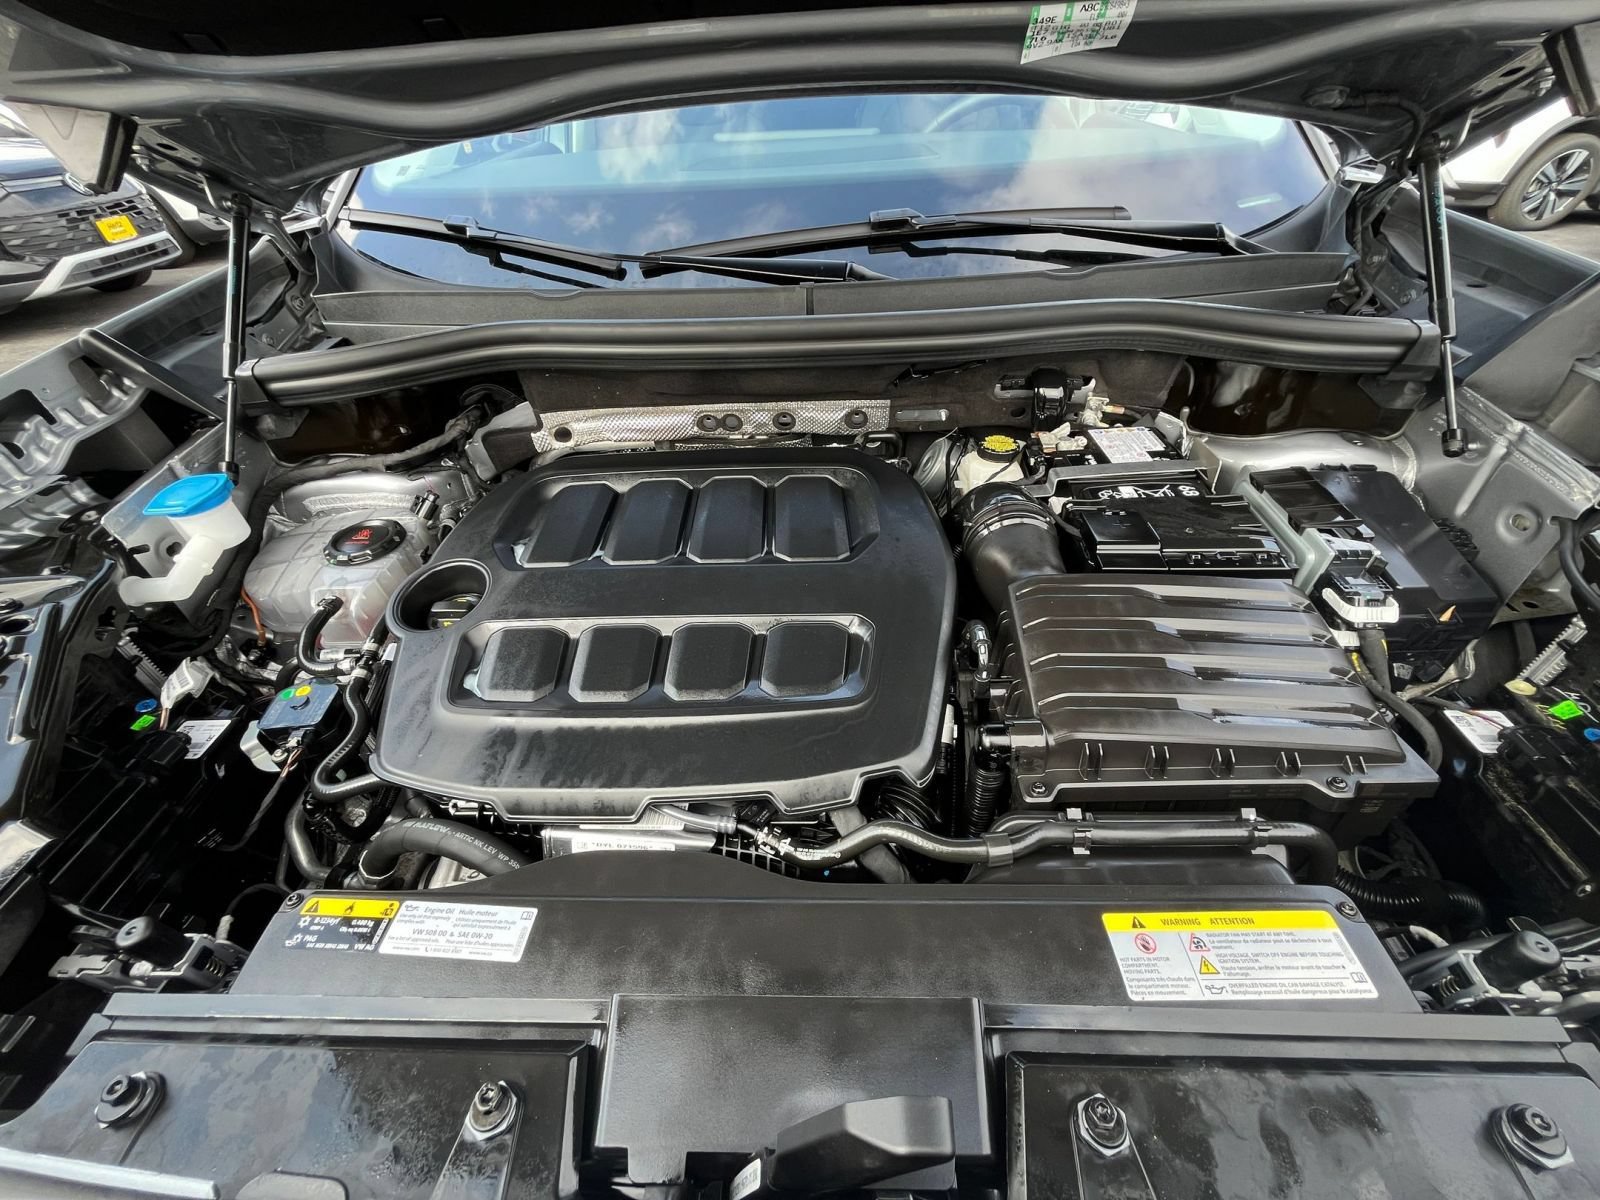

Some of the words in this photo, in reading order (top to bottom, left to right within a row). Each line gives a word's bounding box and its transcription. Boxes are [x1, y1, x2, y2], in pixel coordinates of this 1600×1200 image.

[1080, 2, 1100, 13] ABC
[455, 831, 474, 843] ARTIC
[474, 839, 484, 848] NK
[483, 843, 498, 855] LEV
[424, 906, 444, 914] Engine
[1160, 917, 1201, 926] WARNING
[1208, 917, 1254, 925] ATTENTION
[303, 934, 317, 942] PAG
[470, 931, 493, 939] 0W-20
